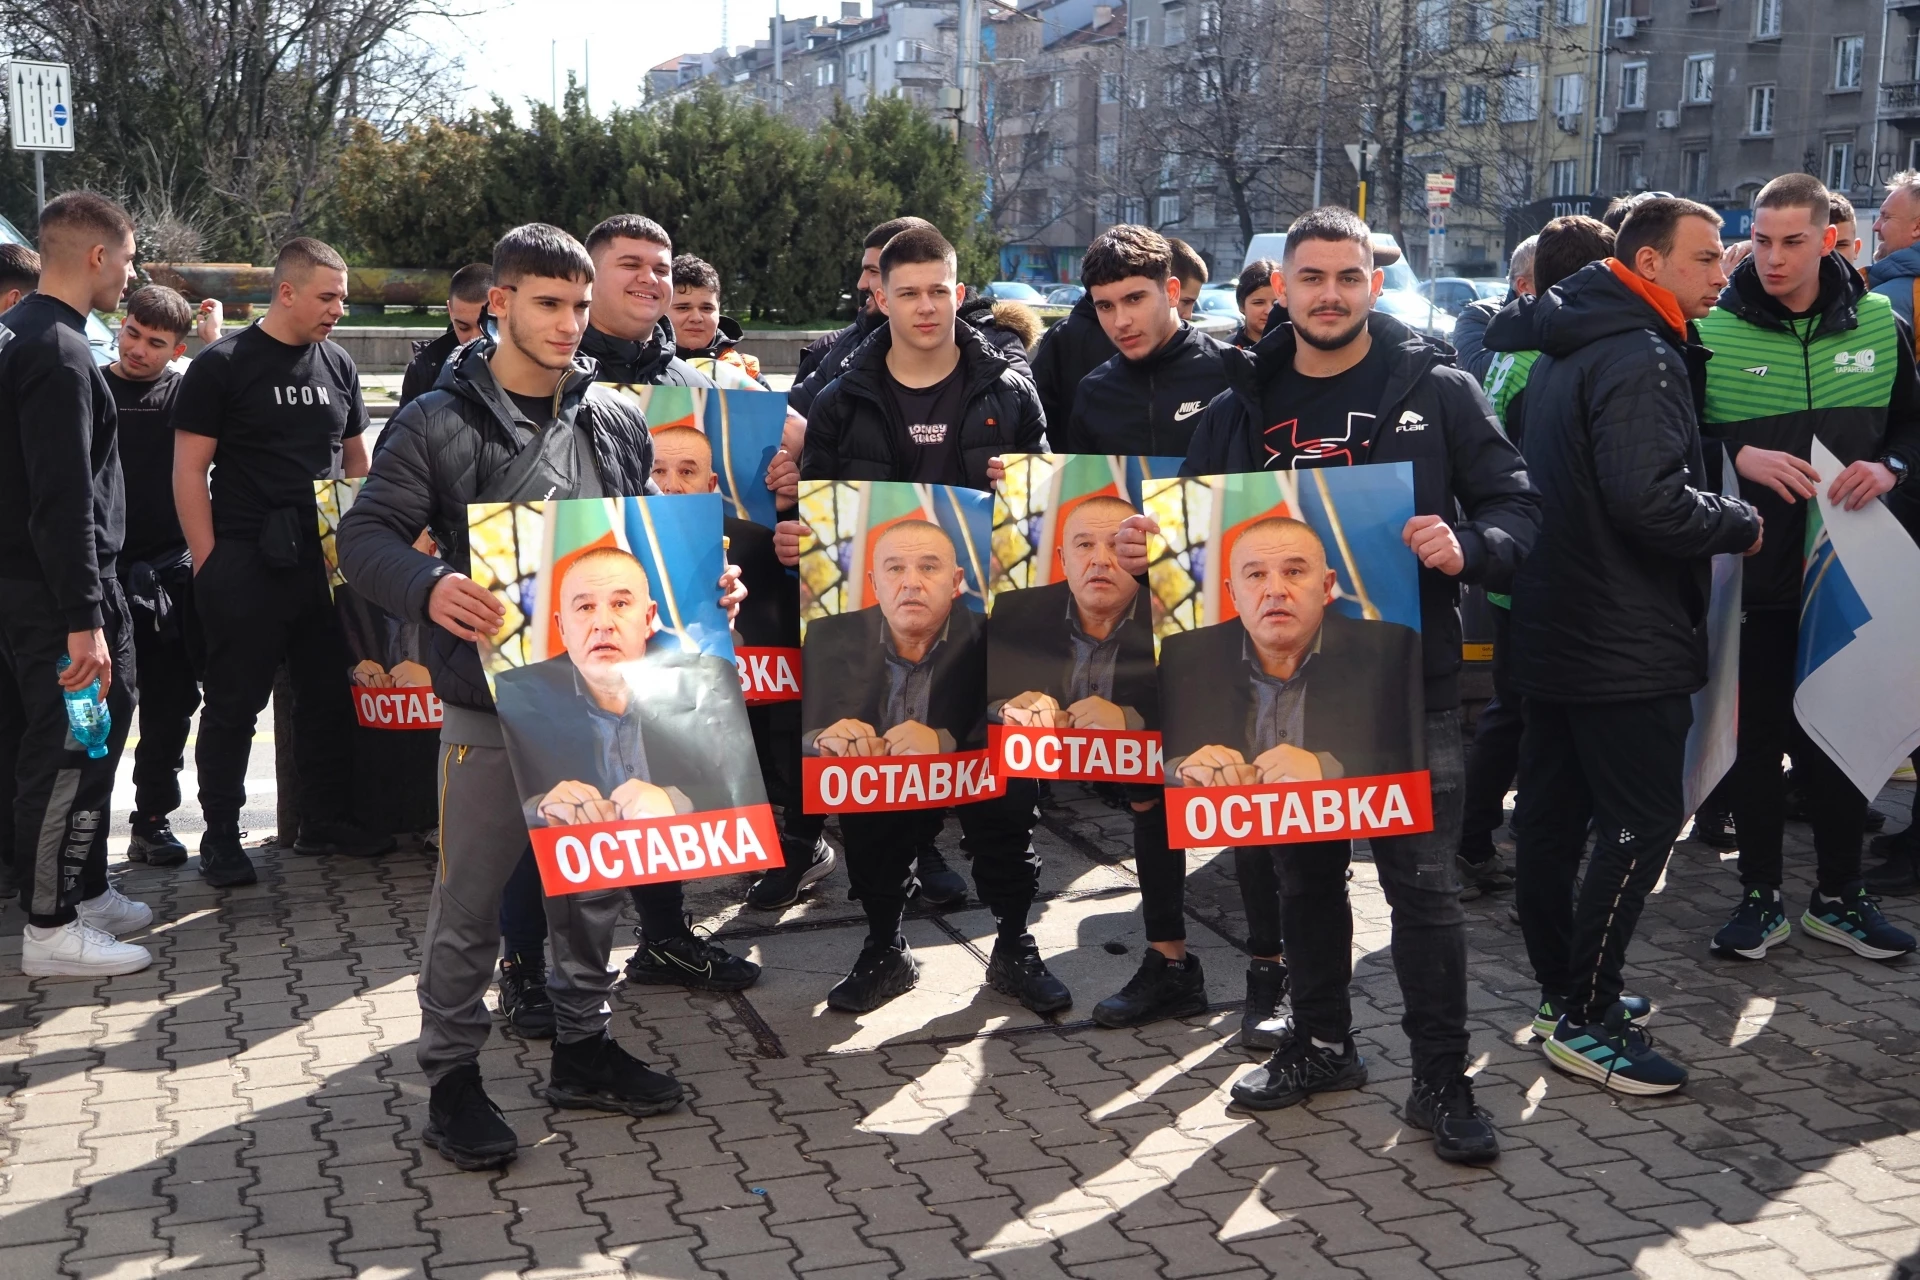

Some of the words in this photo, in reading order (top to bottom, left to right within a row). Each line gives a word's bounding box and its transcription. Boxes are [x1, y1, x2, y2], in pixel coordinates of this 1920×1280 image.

[1551, 201, 1591, 217] TIME
[274, 385, 331, 406] ICON
[1179, 400, 1202, 413] NIKE
[819, 757, 997, 806] ОСТАВКА
[1185, 783, 1414, 840] ОСТАВКА
[555, 817, 768, 884] ОСТАВКА
